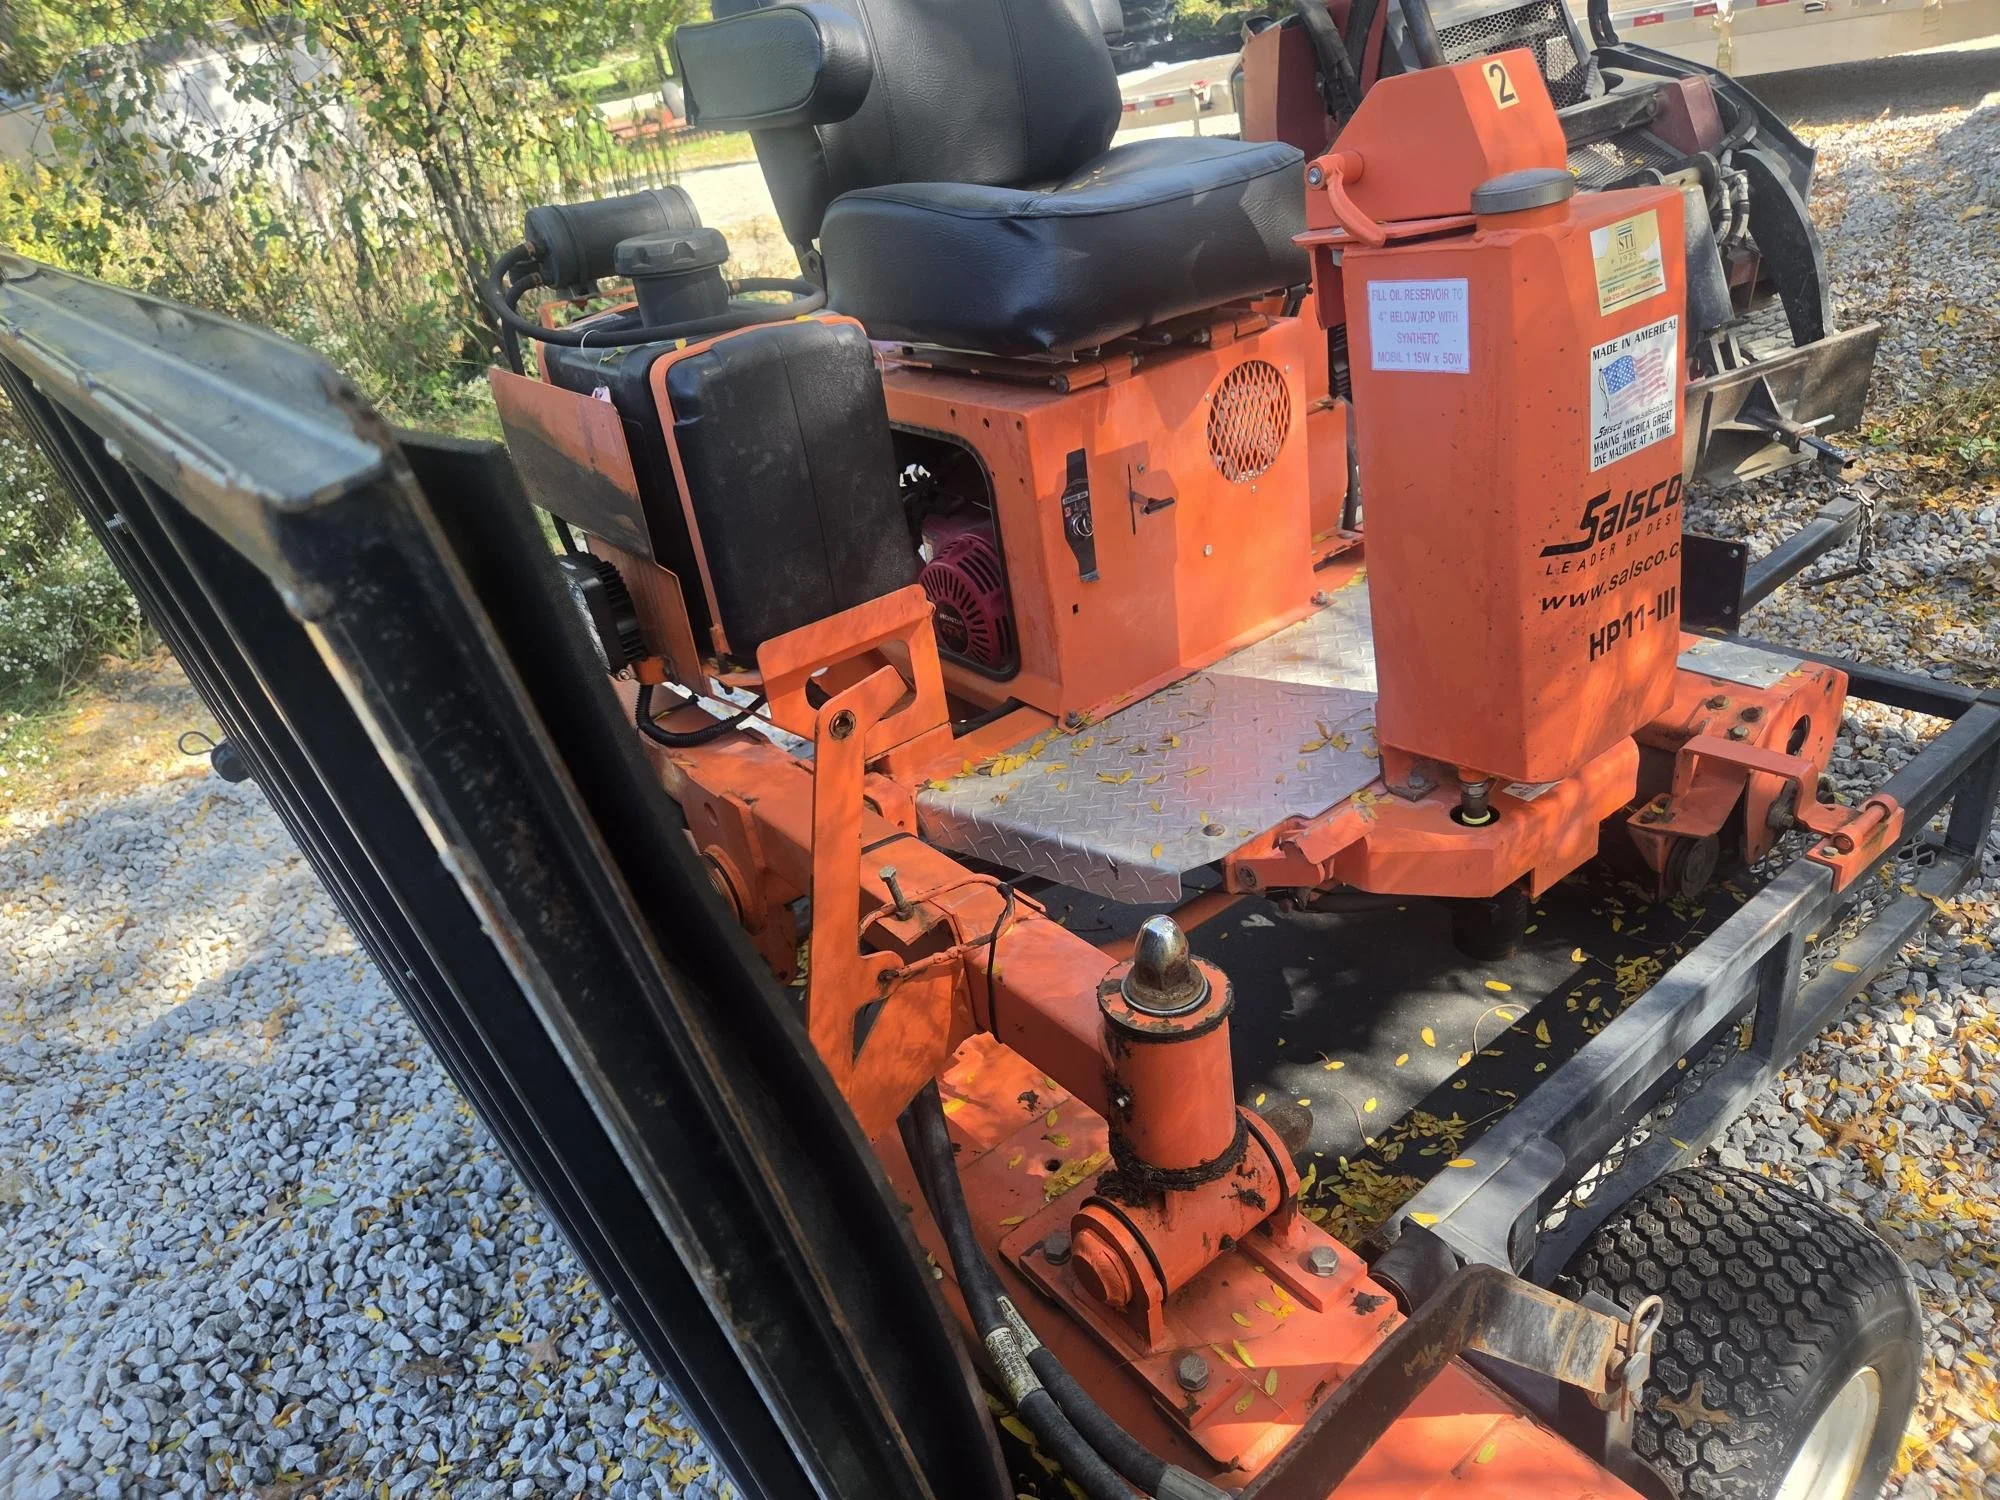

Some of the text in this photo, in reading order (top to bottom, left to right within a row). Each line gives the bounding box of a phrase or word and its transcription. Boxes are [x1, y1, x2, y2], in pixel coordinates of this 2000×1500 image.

[1488, 64, 1516, 104] 2
[1371, 288, 1464, 300] FILL OIL RESERVOIR TO
[1390, 311, 1416, 323] BELOW
[1418, 311, 1436, 323] TOP
[1438, 311, 1458, 322] WITH
[1378, 352, 1403, 362] MOBIL
[1406, 352, 1410, 362] 1
[1414, 352, 1431, 364] 15W
[1442, 352, 1463, 364] 50W
[1396, 332, 1440, 344] SYNTHETIC
[1592, 318, 1676, 361] MADE IN AMERICA!
[1593, 410, 1673, 451] MAKING AMERICA GREAT
[1595, 400, 1673, 440] Salsco www.salsco.com
[1594, 424, 1672, 468] ONE MACHINE AT A TIME.
[1539, 473, 1682, 558] Salsco
[1546, 542, 1616, 576] LEADER
[1626, 534, 1639, 548] BY
[1542, 542, 1681, 611] www.salsco.c
[1589, 586, 1676, 662] HP11-III
